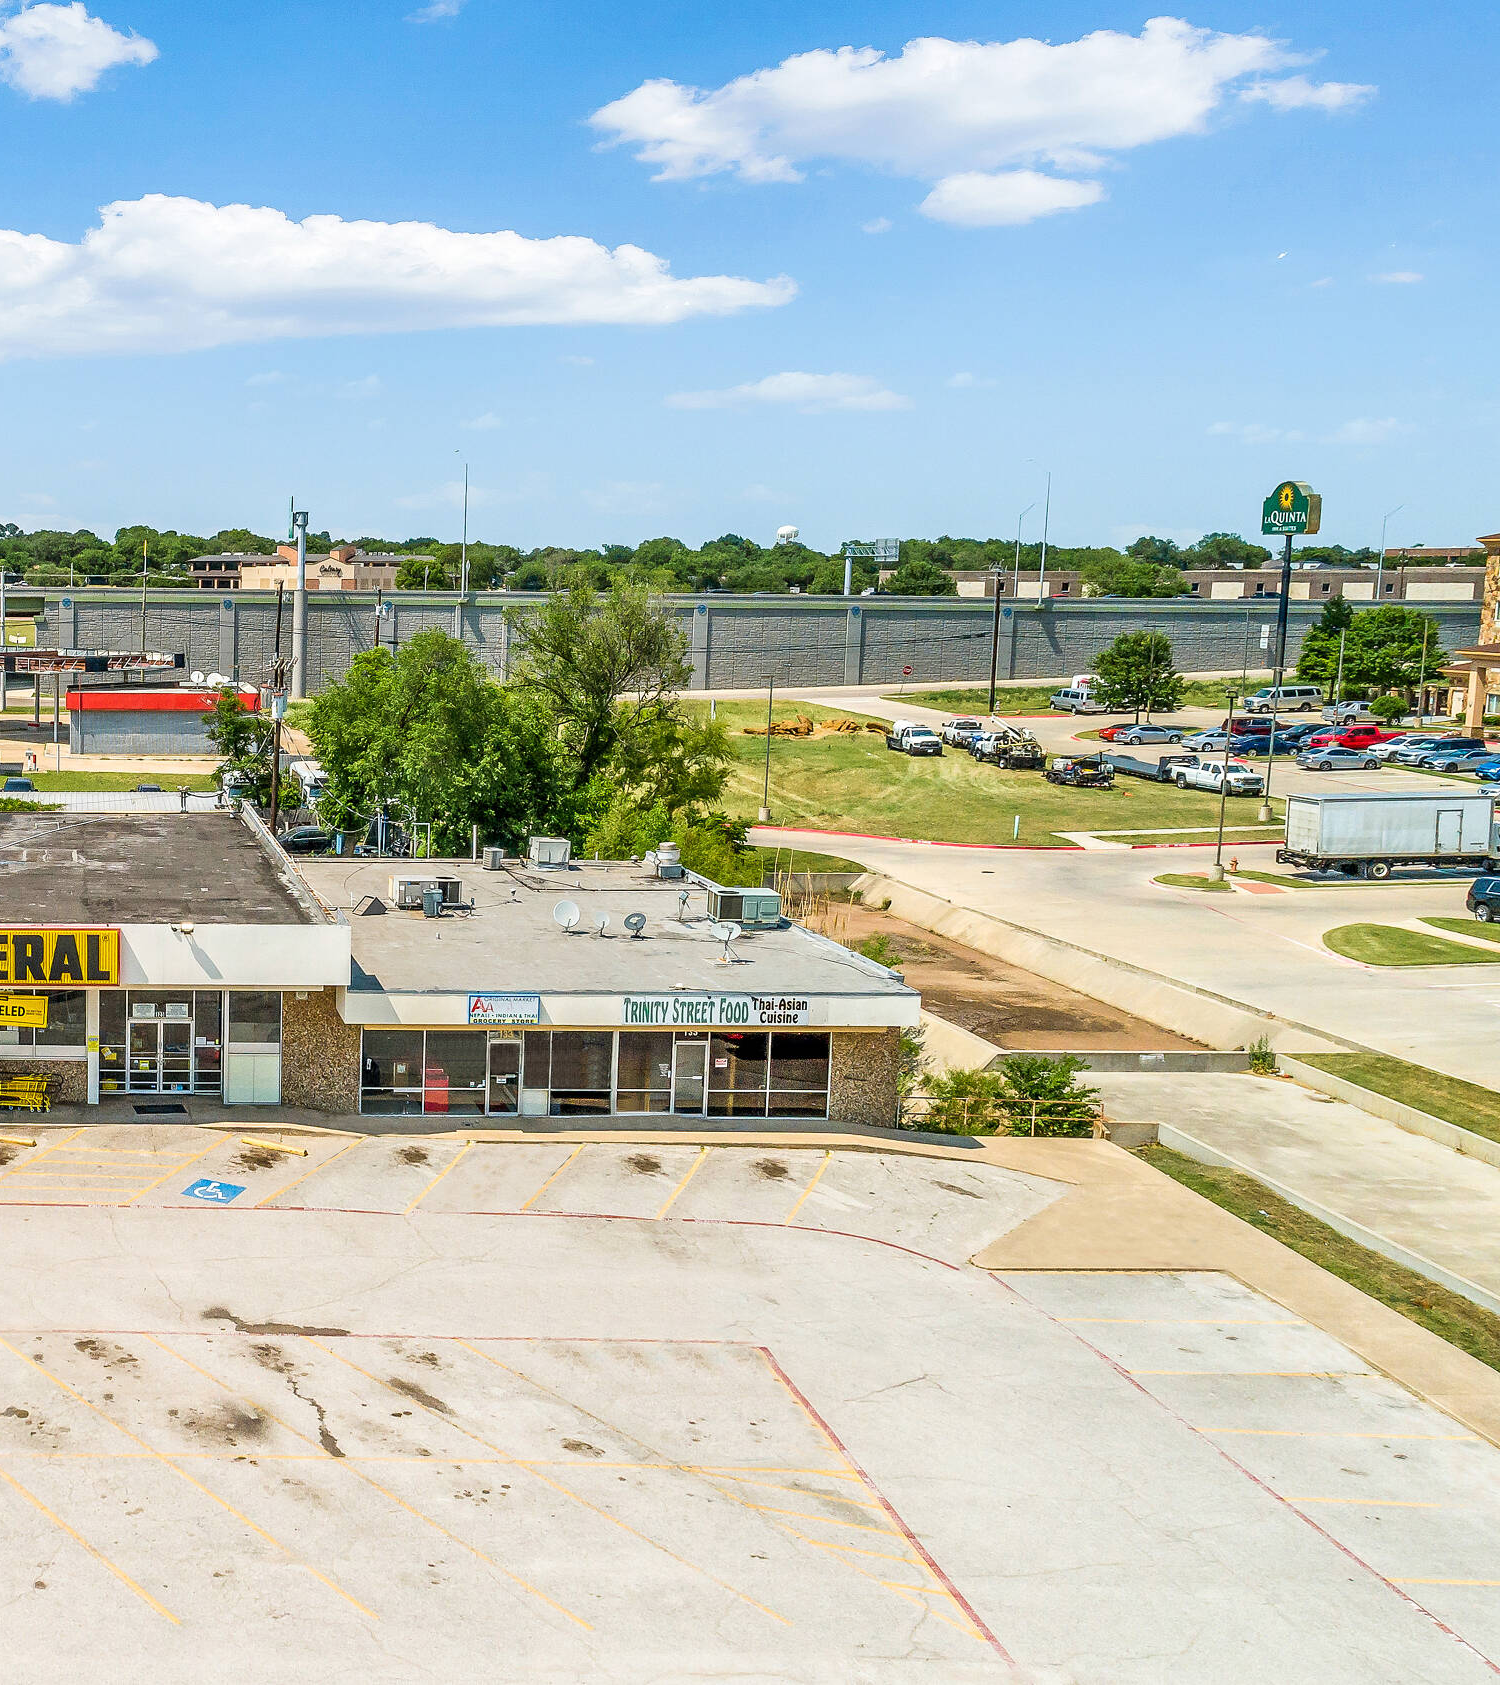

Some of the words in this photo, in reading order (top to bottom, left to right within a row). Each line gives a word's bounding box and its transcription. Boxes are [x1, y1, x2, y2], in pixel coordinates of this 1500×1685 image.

[1271, 511, 1306, 526] QUINTA
[623, 997, 669, 1023] TRINITY
[672, 997, 716, 1024] STREET
[719, 997, 749, 1023] FOOD
[753, 997, 808, 1011] Thai-Asian
[759, 1011, 799, 1024] Cuisine
